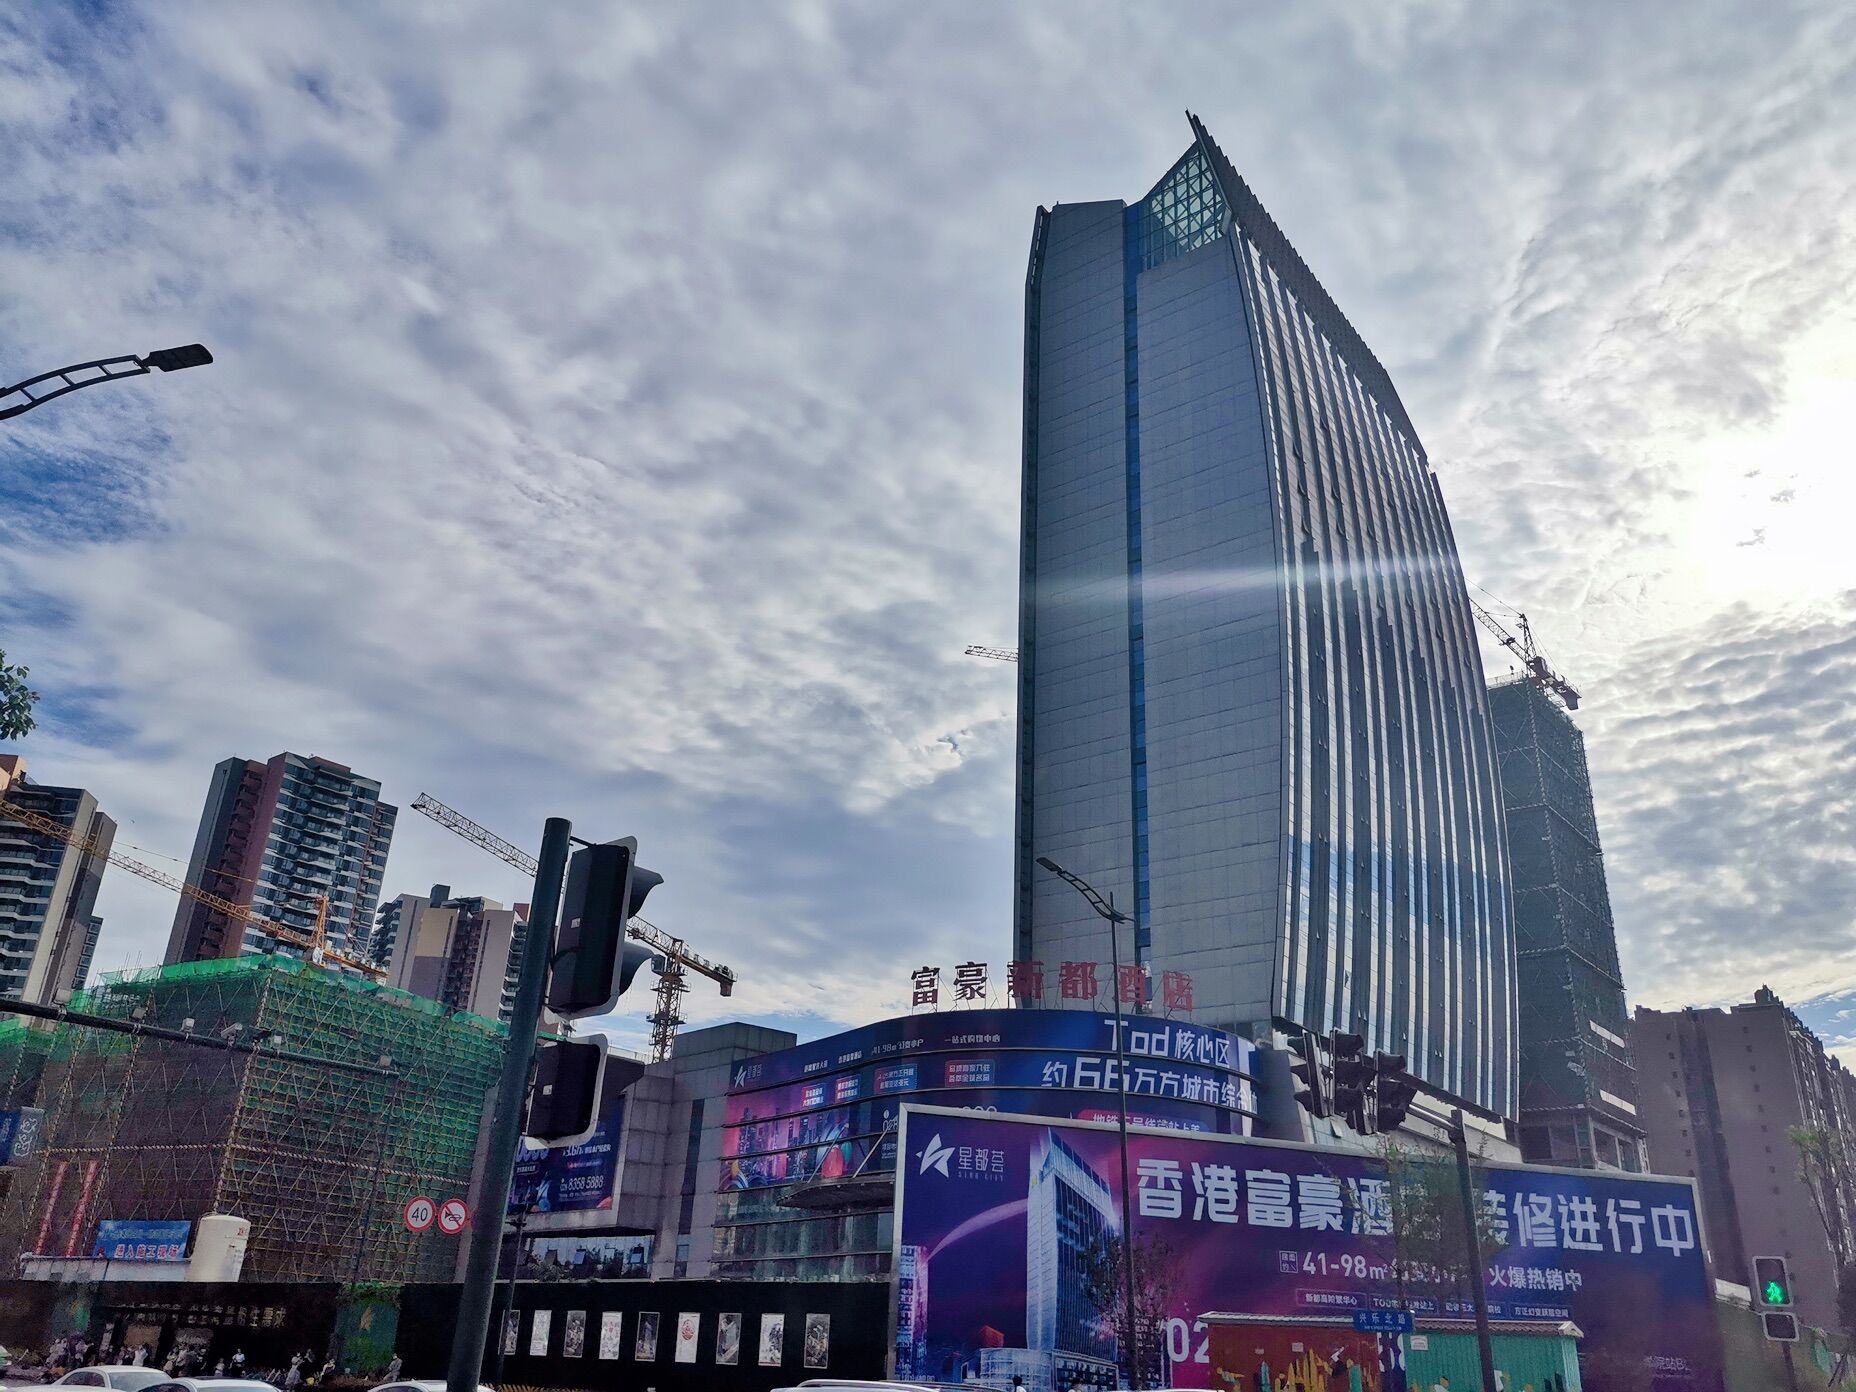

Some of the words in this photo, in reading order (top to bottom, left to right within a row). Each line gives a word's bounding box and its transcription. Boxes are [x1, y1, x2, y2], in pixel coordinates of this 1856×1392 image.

[958, 1146, 1005, 1173] 星都荟
[411, 1207, 428, 1222] 40
[1488, 1264, 1583, 1292] 火爆热销中
